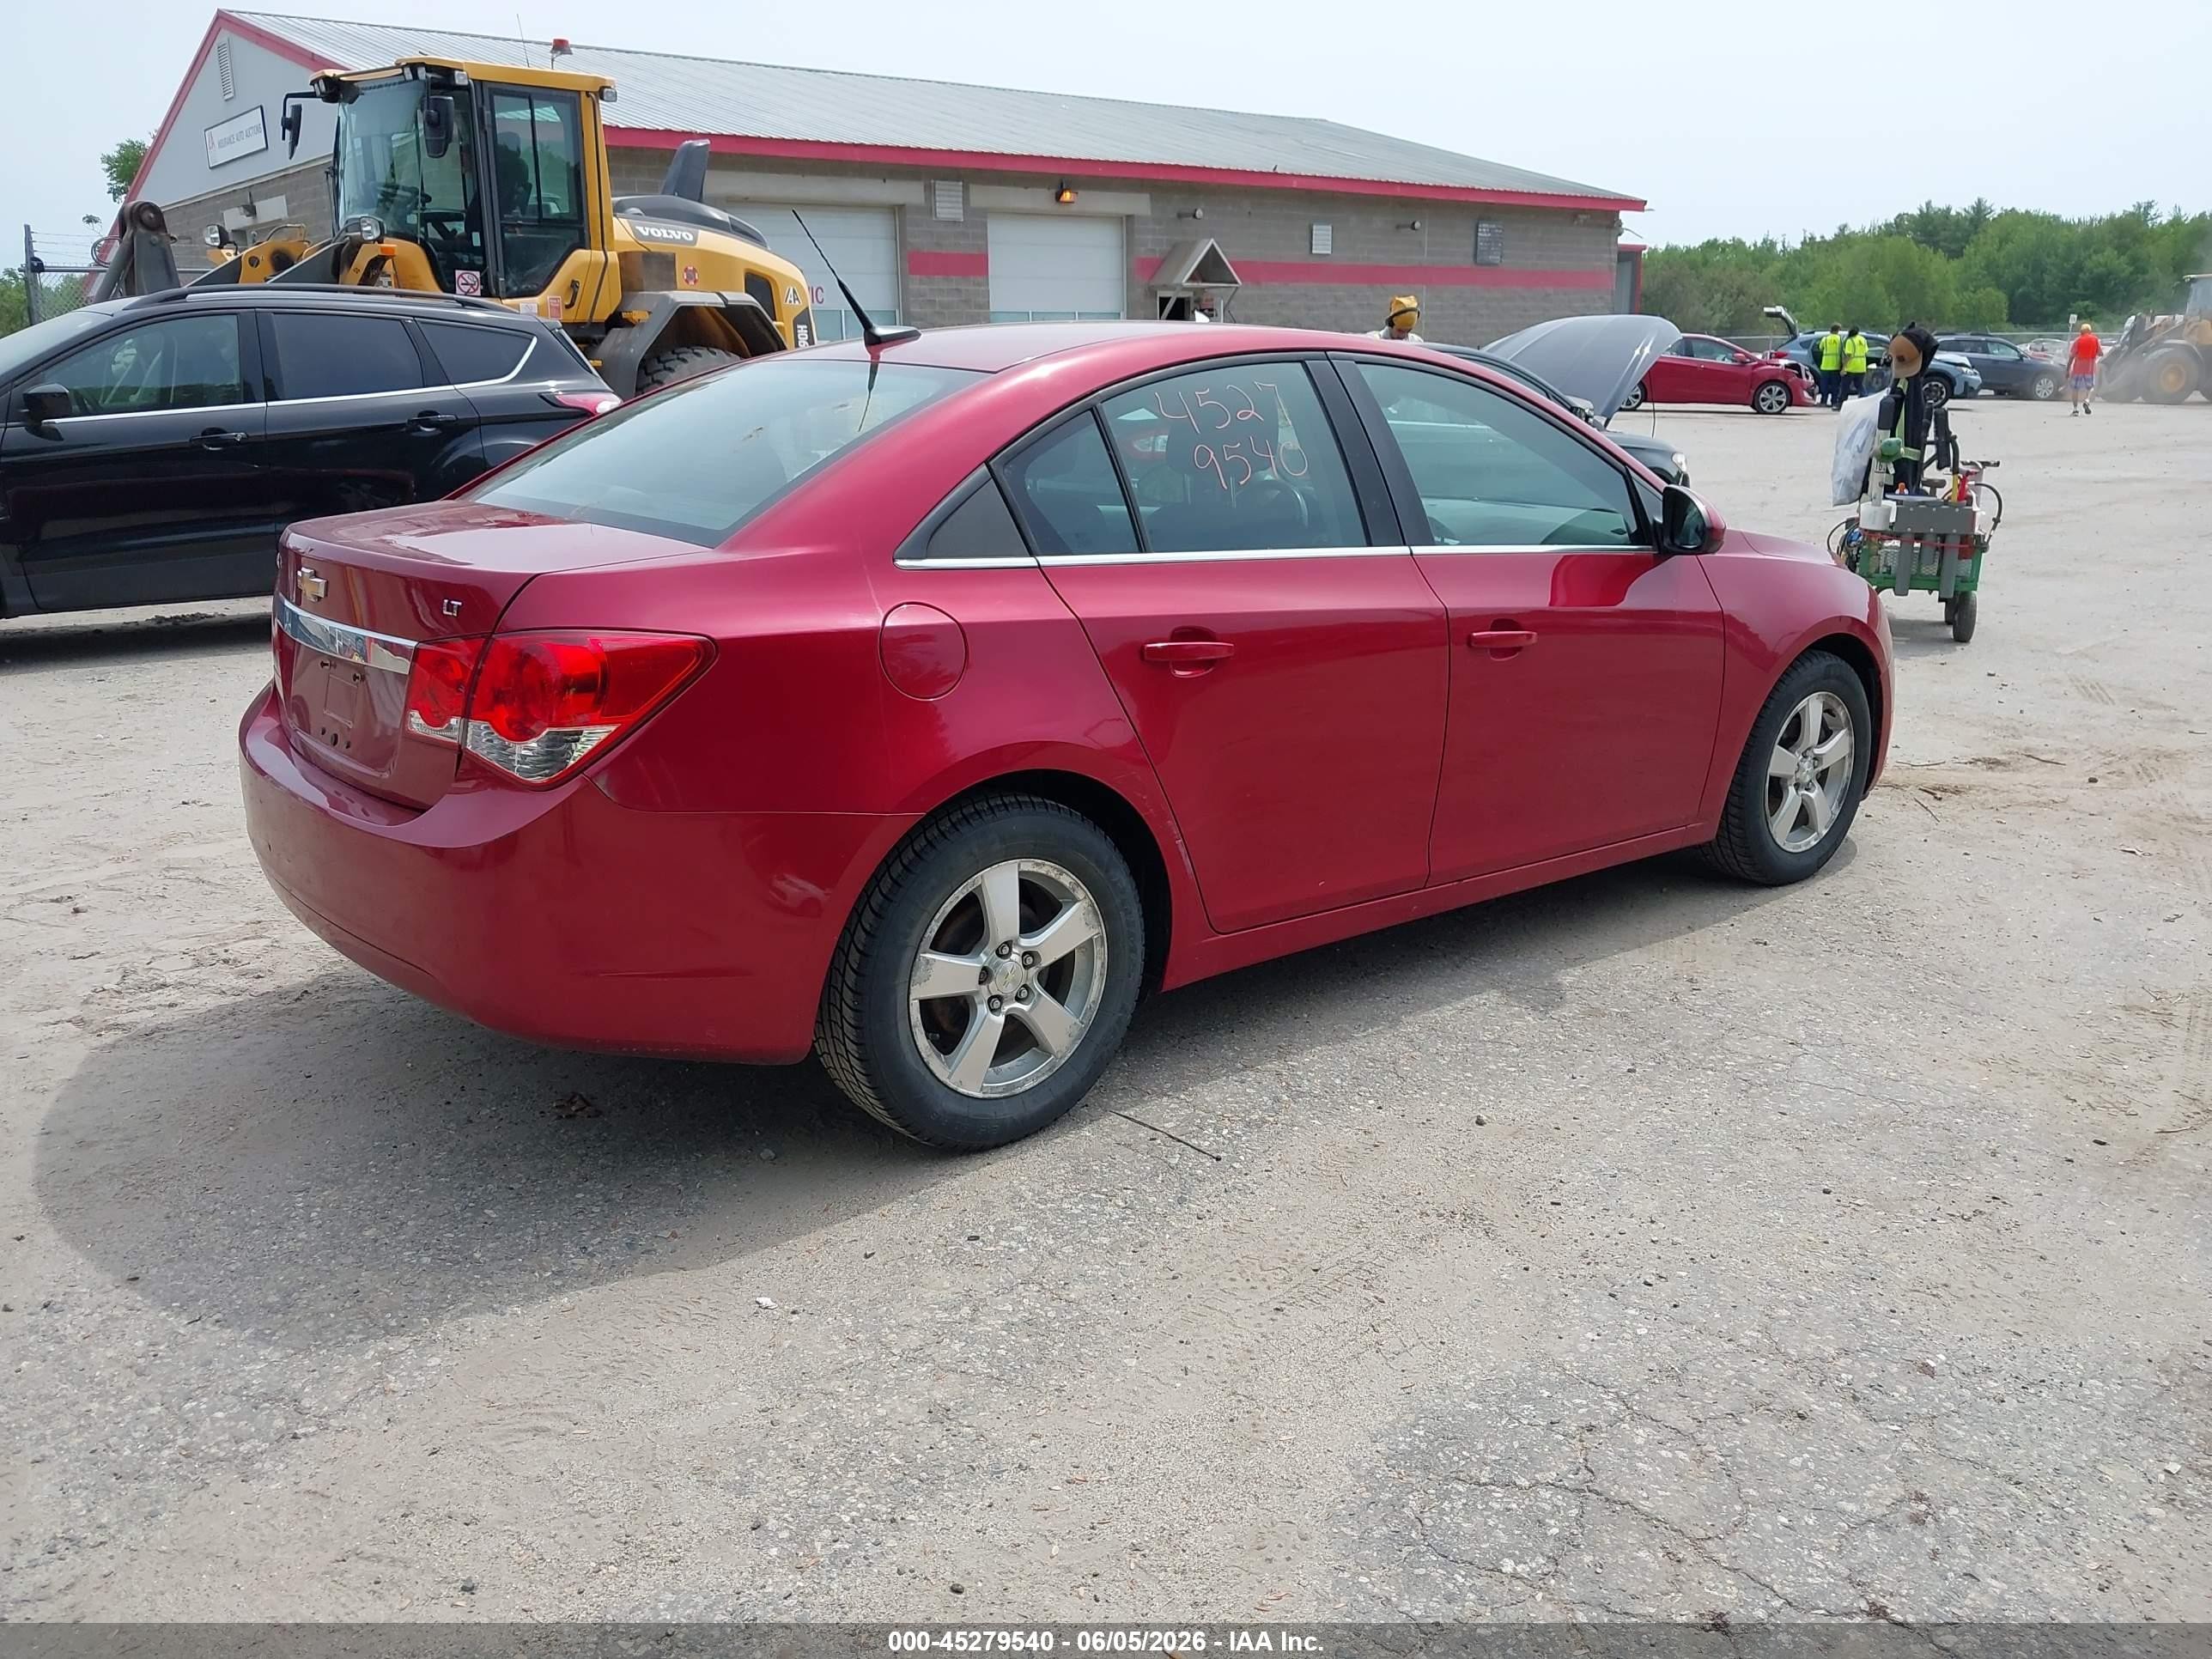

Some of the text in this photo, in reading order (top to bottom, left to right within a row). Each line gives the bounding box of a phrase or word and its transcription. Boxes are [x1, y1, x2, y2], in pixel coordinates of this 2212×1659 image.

[635, 226, 694, 241] VOLVO
[808, 285, 824, 304] IC
[1154, 380, 1292, 434] 4527
[1194, 435, 1309, 490] 9540
[442, 599, 463, 617] LT
